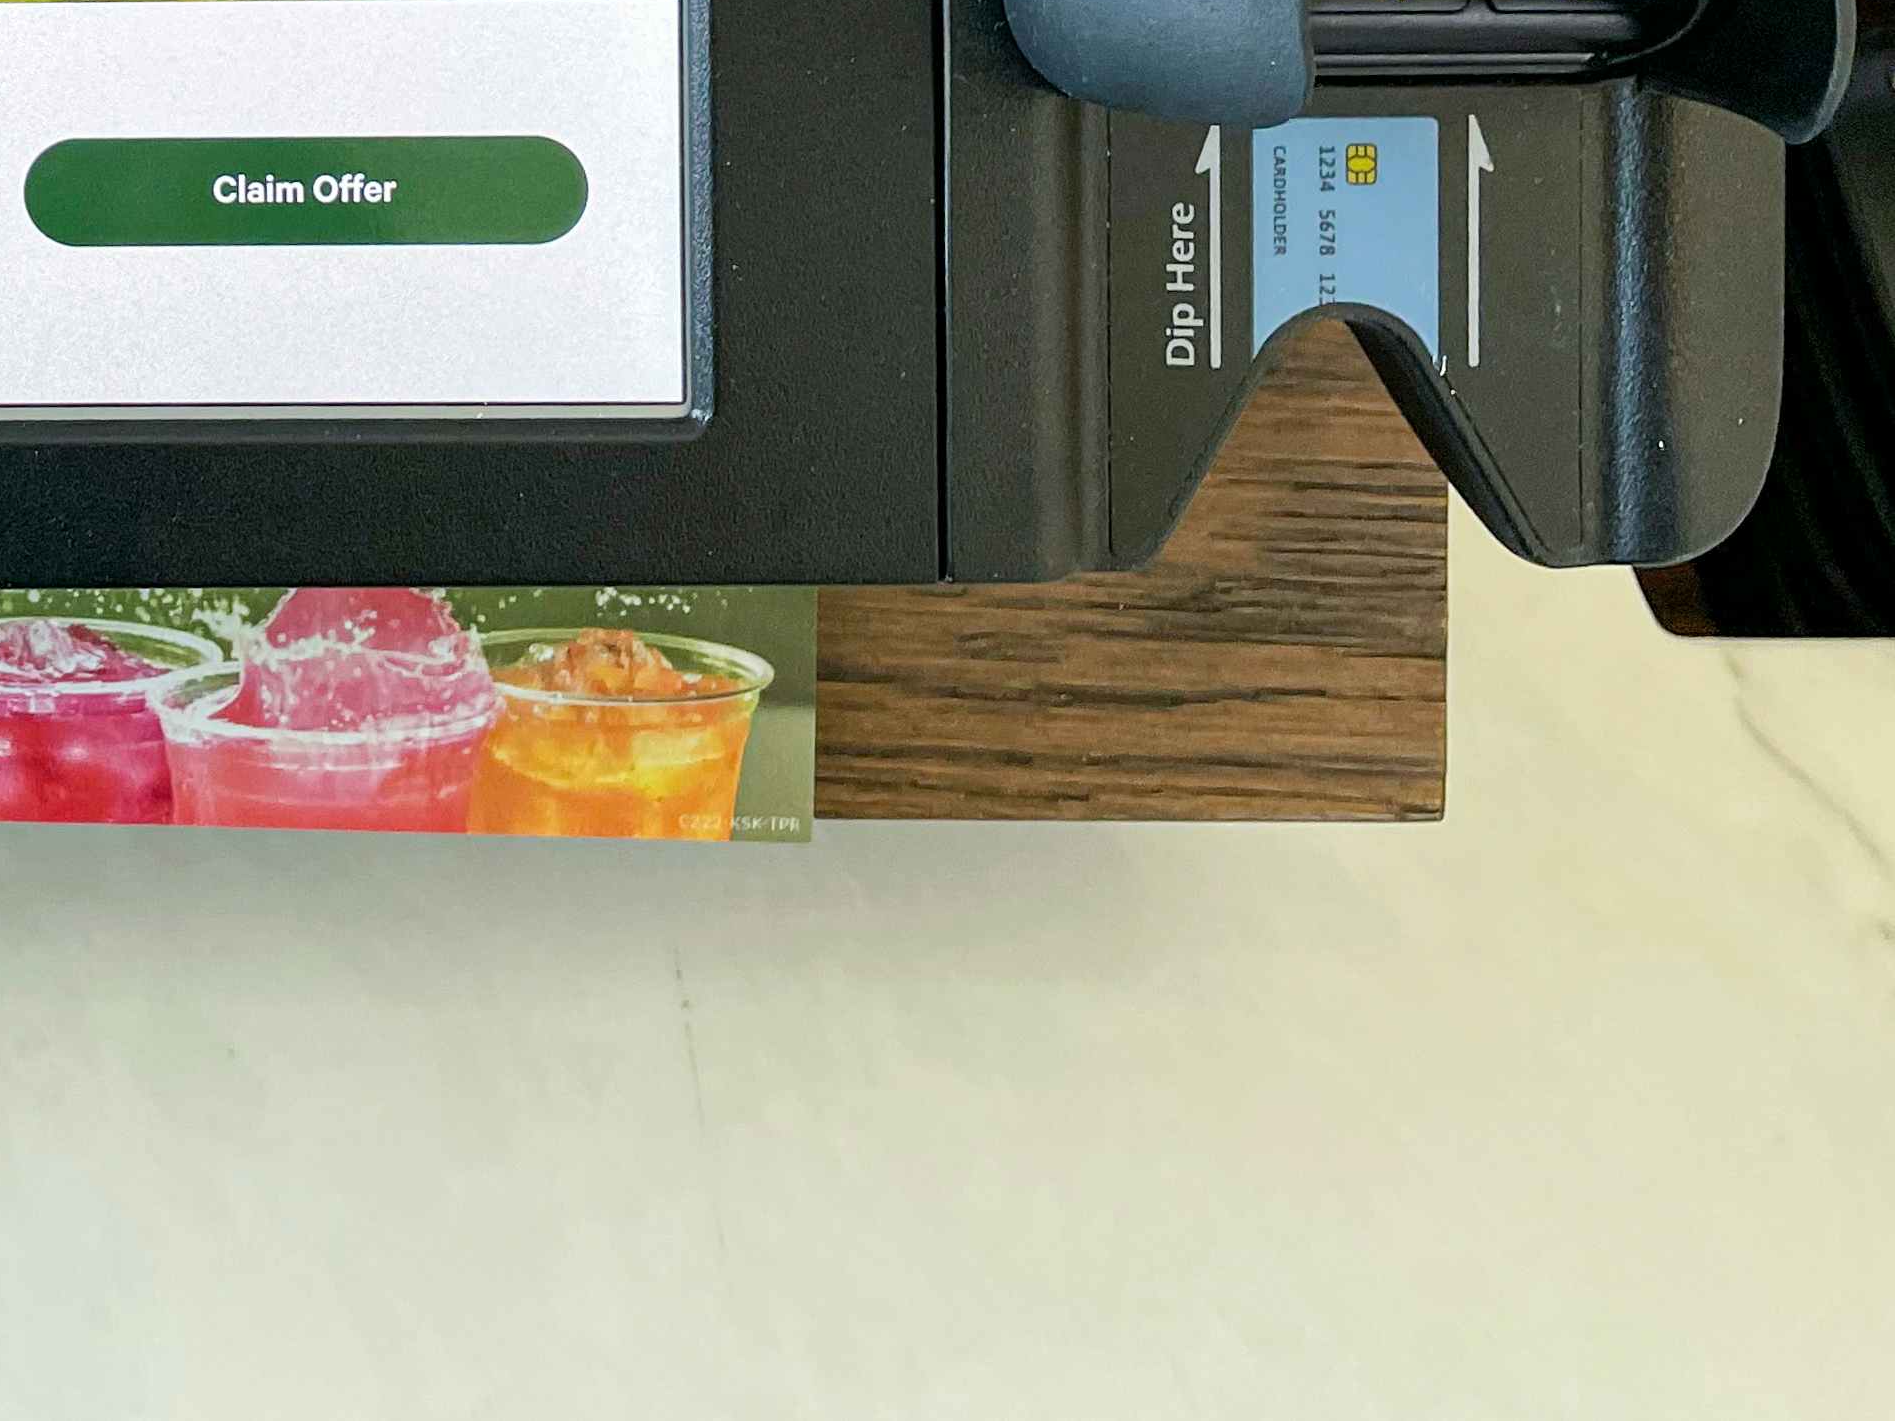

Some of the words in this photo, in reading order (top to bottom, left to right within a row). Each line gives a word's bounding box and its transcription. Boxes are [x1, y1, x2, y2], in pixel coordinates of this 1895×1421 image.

[213, 174, 305, 203] Claim
[313, 173, 397, 203] Offer
[1319, 146, 1336, 192] 1234
[1273, 145, 1287, 256] CARDHOLDER
[1165, 201, 1196, 292] Here
[1318, 210, 1336, 256] 5678
[1165, 294, 1203, 367] Dip
